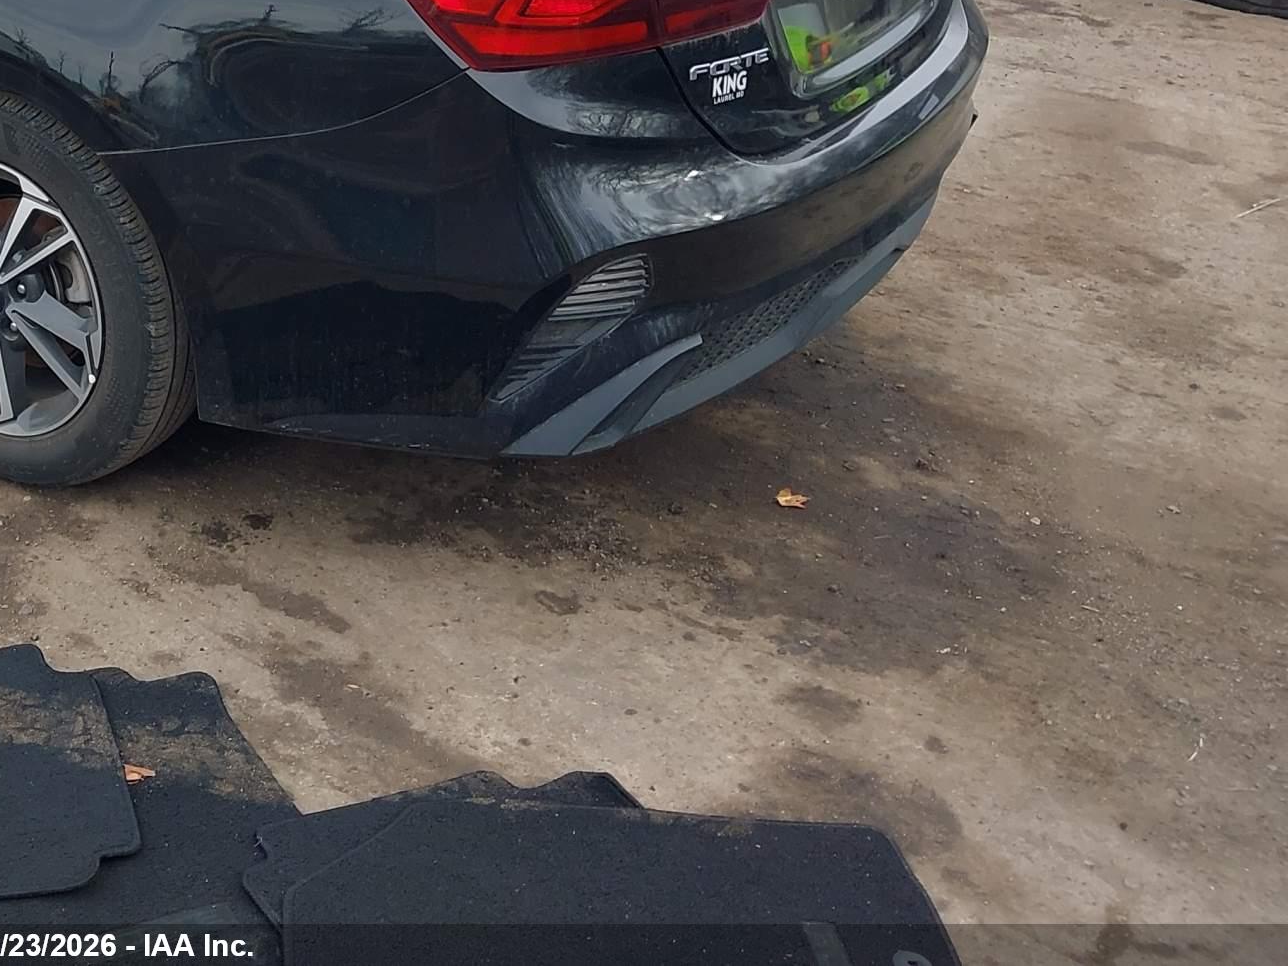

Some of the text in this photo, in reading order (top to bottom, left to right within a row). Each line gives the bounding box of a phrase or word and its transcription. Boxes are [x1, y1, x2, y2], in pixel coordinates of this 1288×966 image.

[689, 47, 769, 81] FORTE
[712, 70, 748, 98] KING
[713, 93, 735, 105] LAUREL
